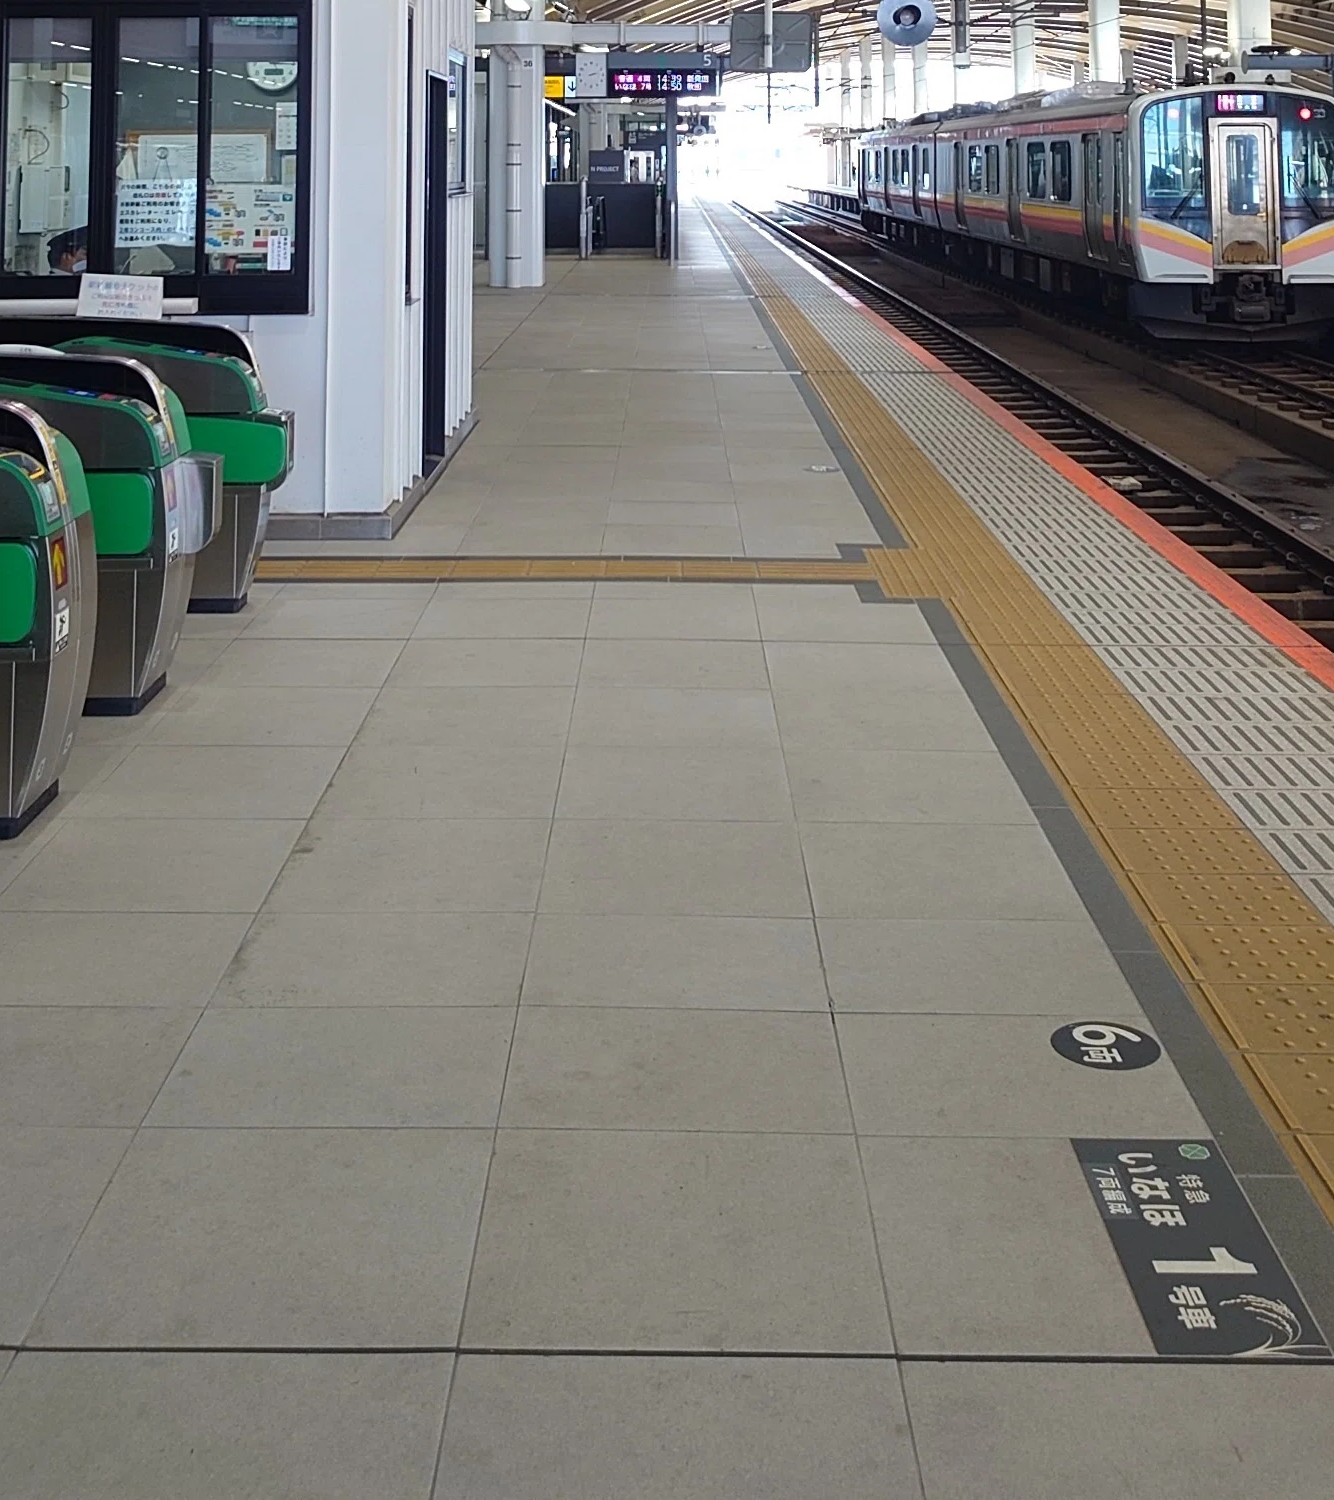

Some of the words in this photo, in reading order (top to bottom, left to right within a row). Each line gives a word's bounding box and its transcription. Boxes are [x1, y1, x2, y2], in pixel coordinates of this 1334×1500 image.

[703, 54, 712, 66] 5
[1071, 1023, 1143, 1064] 6両
[1117, 1151, 1187, 1228] いなほ
[1175, 1173, 1211, 1205] 特急
[1151, 1246, 1258, 1275] 1
[1168, 1285, 1216, 1330] 号車
